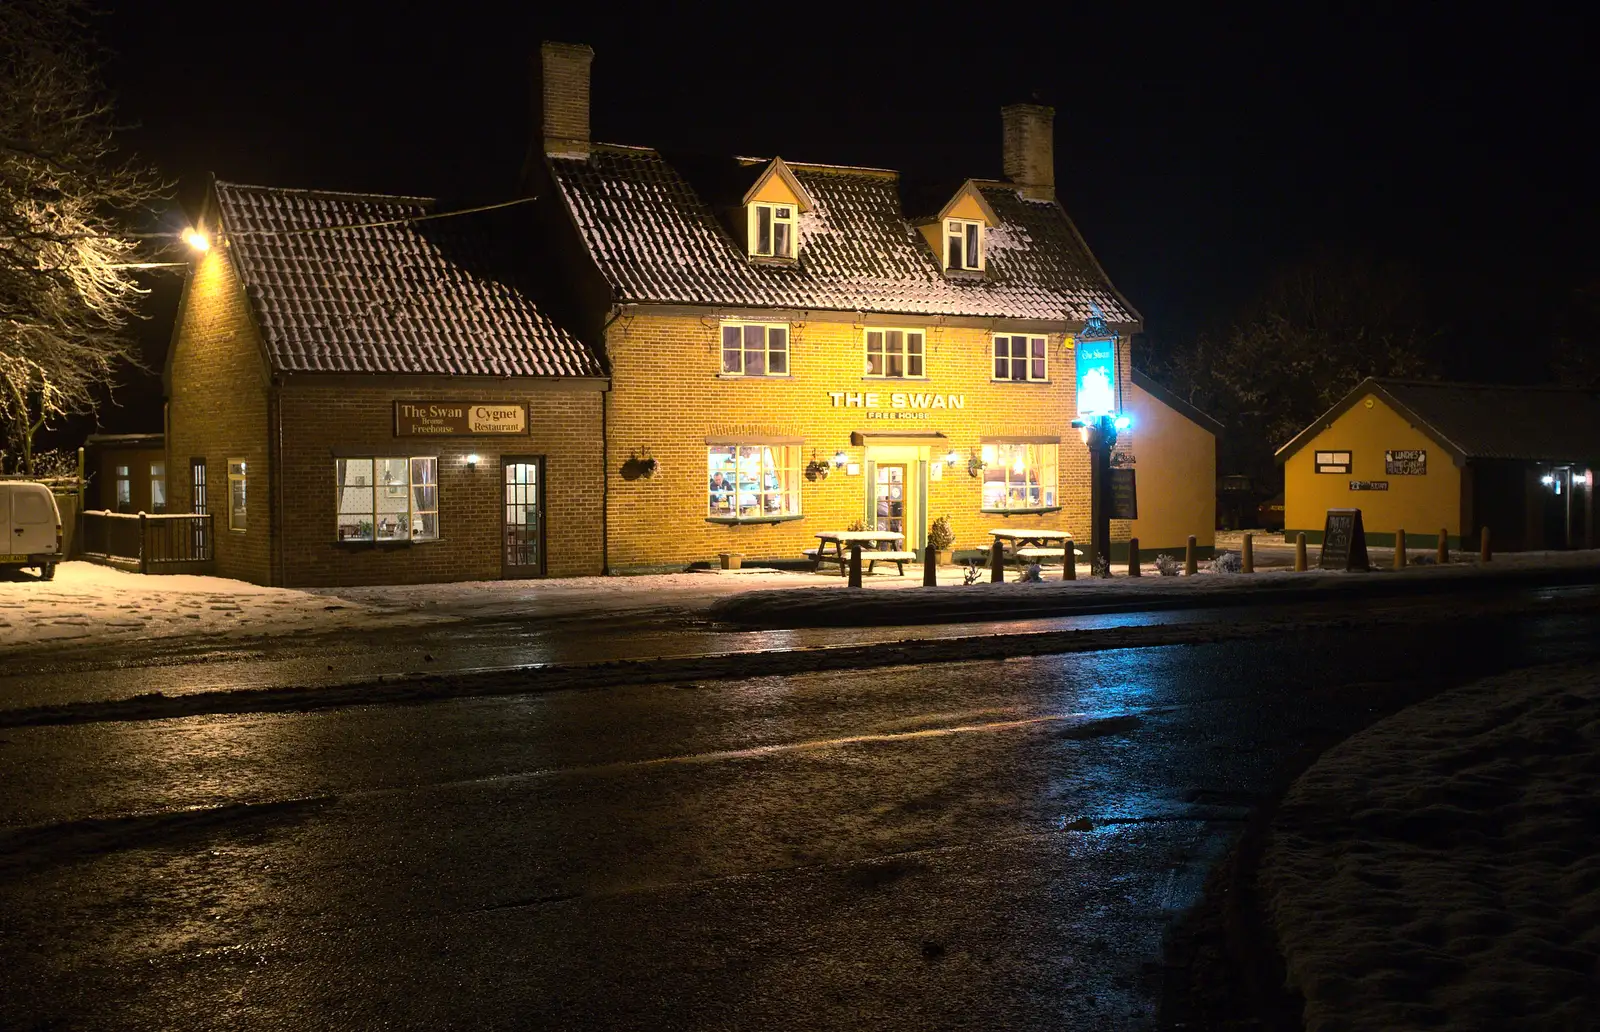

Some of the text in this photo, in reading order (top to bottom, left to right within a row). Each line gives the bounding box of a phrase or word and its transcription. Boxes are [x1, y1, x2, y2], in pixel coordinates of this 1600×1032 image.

[827, 391, 965, 409] THE SWAN
[401, 405, 462, 418] The Swan
[476, 407, 517, 421] Cygnet
[412, 424, 454, 433] Freehouse
[474, 422, 519, 431] Restaurant
